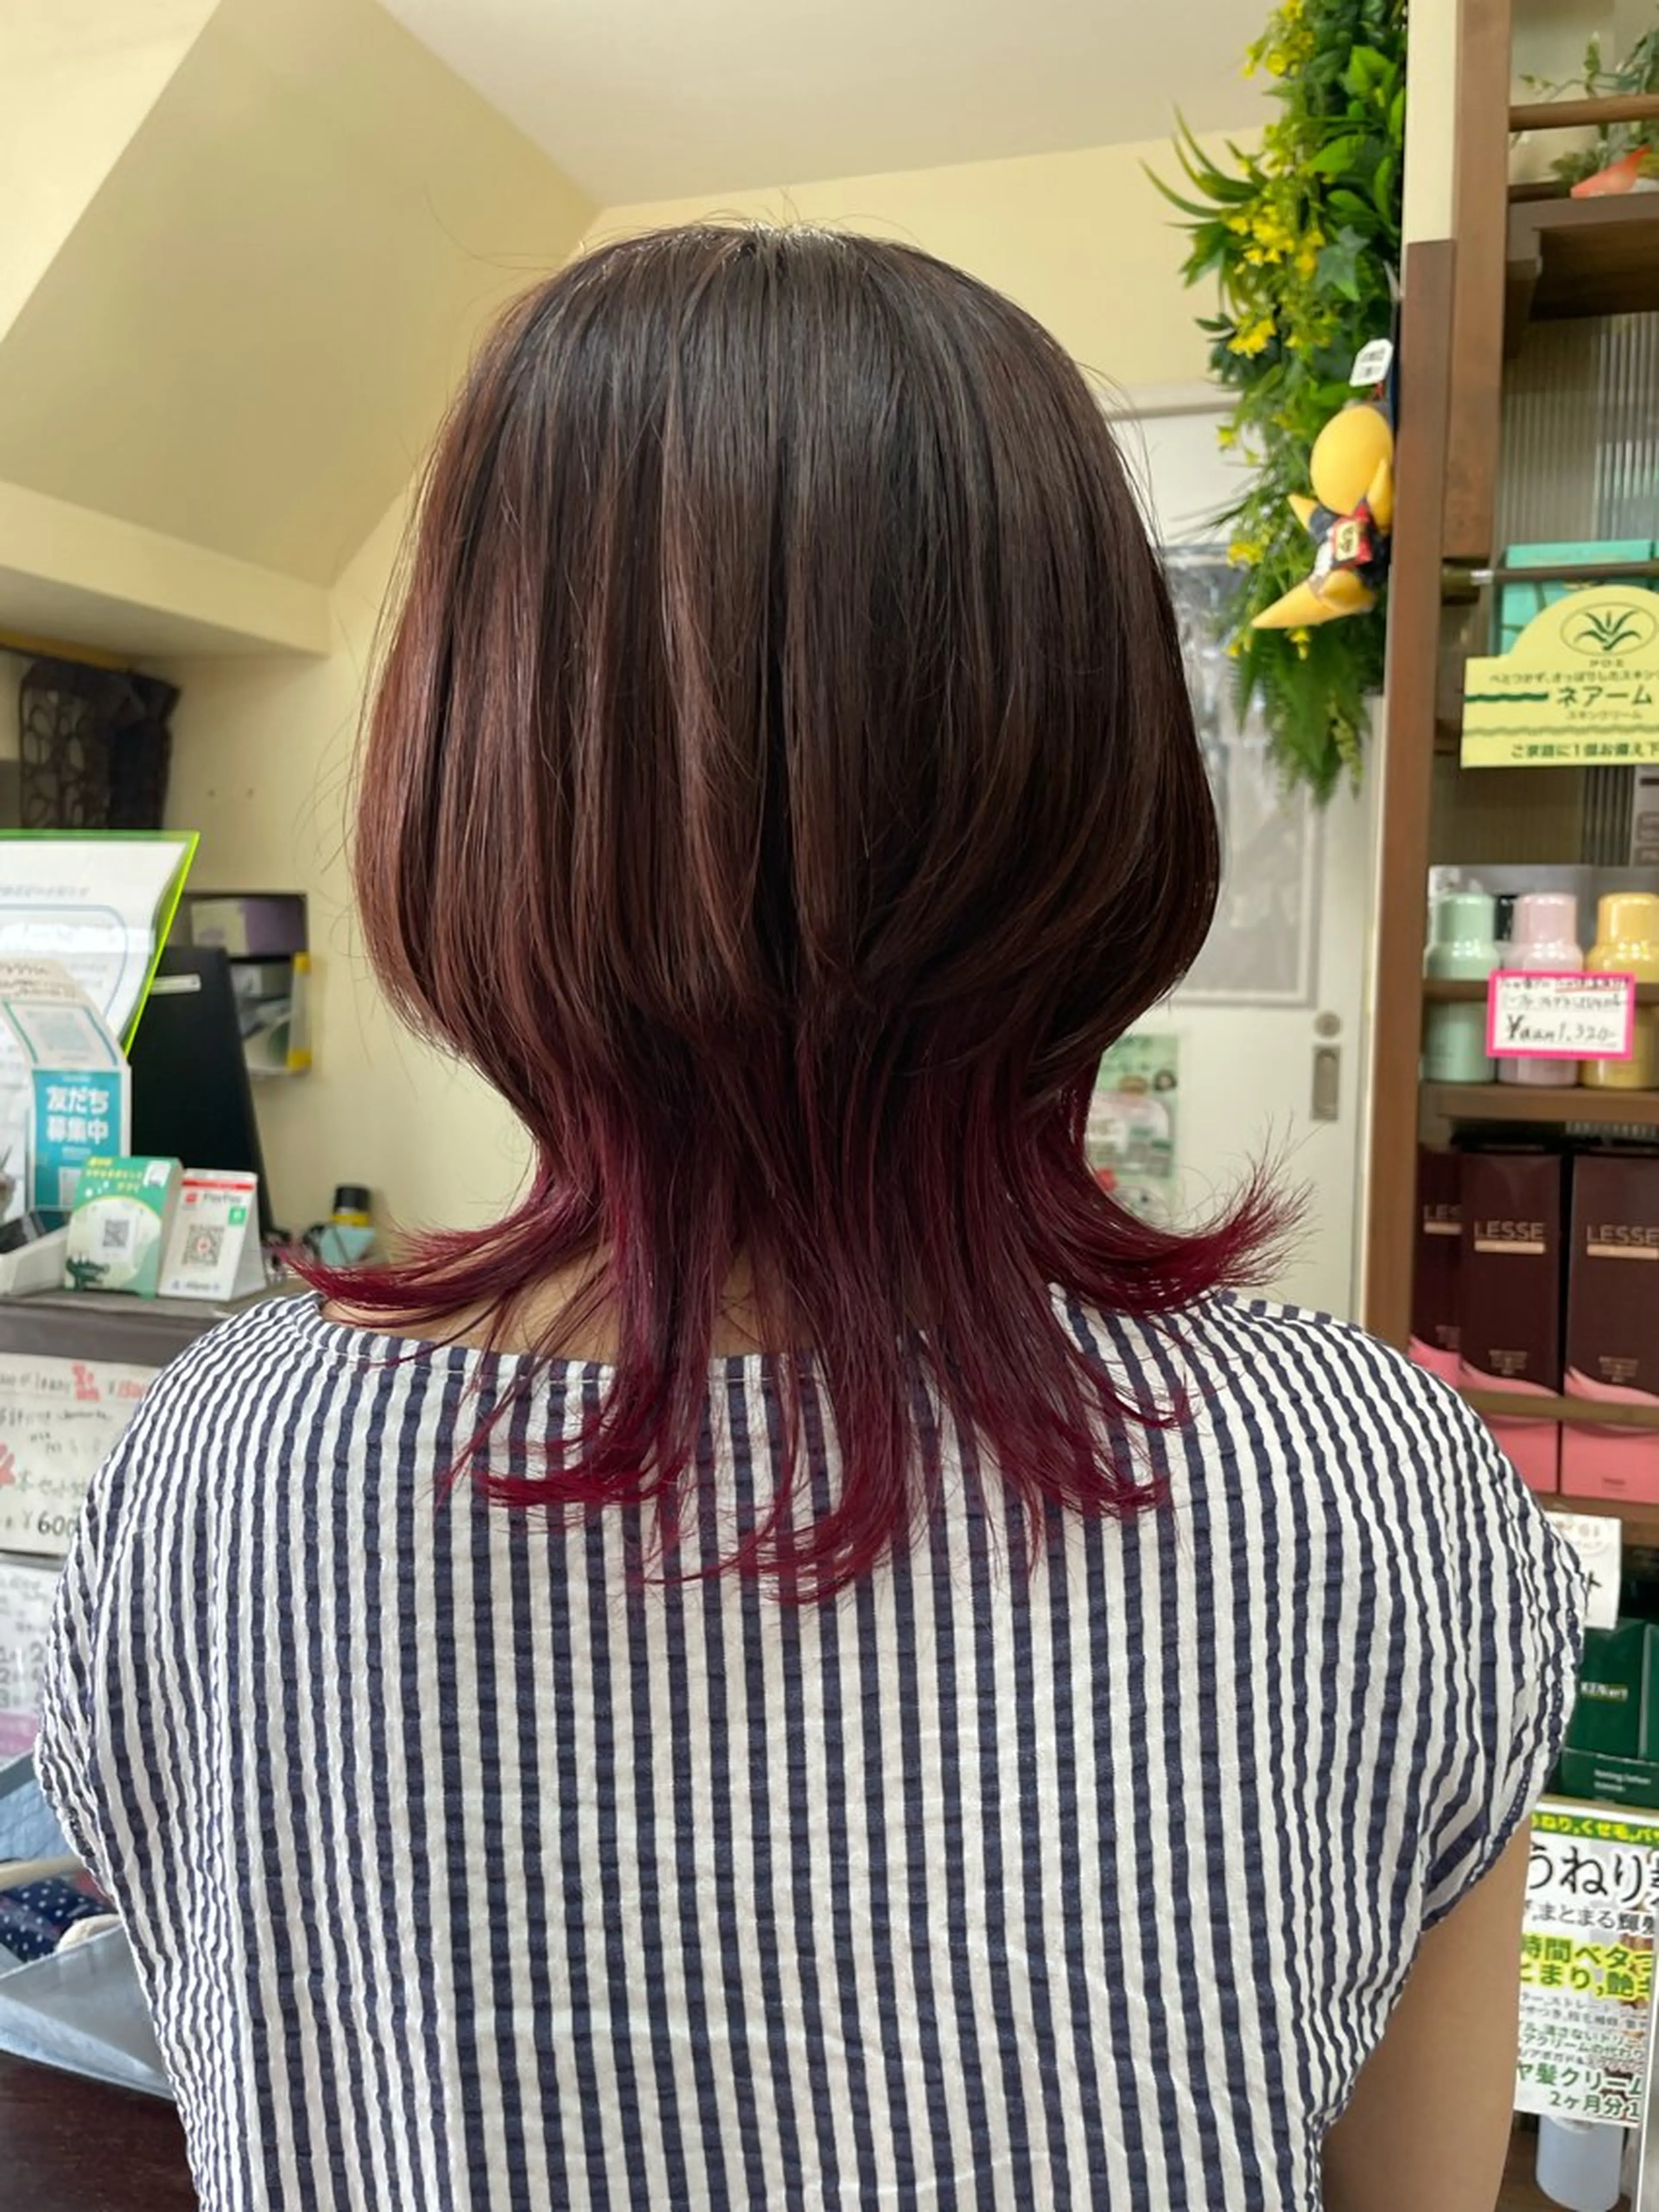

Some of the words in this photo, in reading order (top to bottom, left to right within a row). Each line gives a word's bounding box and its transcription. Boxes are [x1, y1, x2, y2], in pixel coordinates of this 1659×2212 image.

[1557, 684, 1653, 708] ネアーム
[46, 1085, 109, 1115] 友だち
[47, 1115, 109, 1145] 募集中
[1474, 1220, 1546, 1240] LESSE
